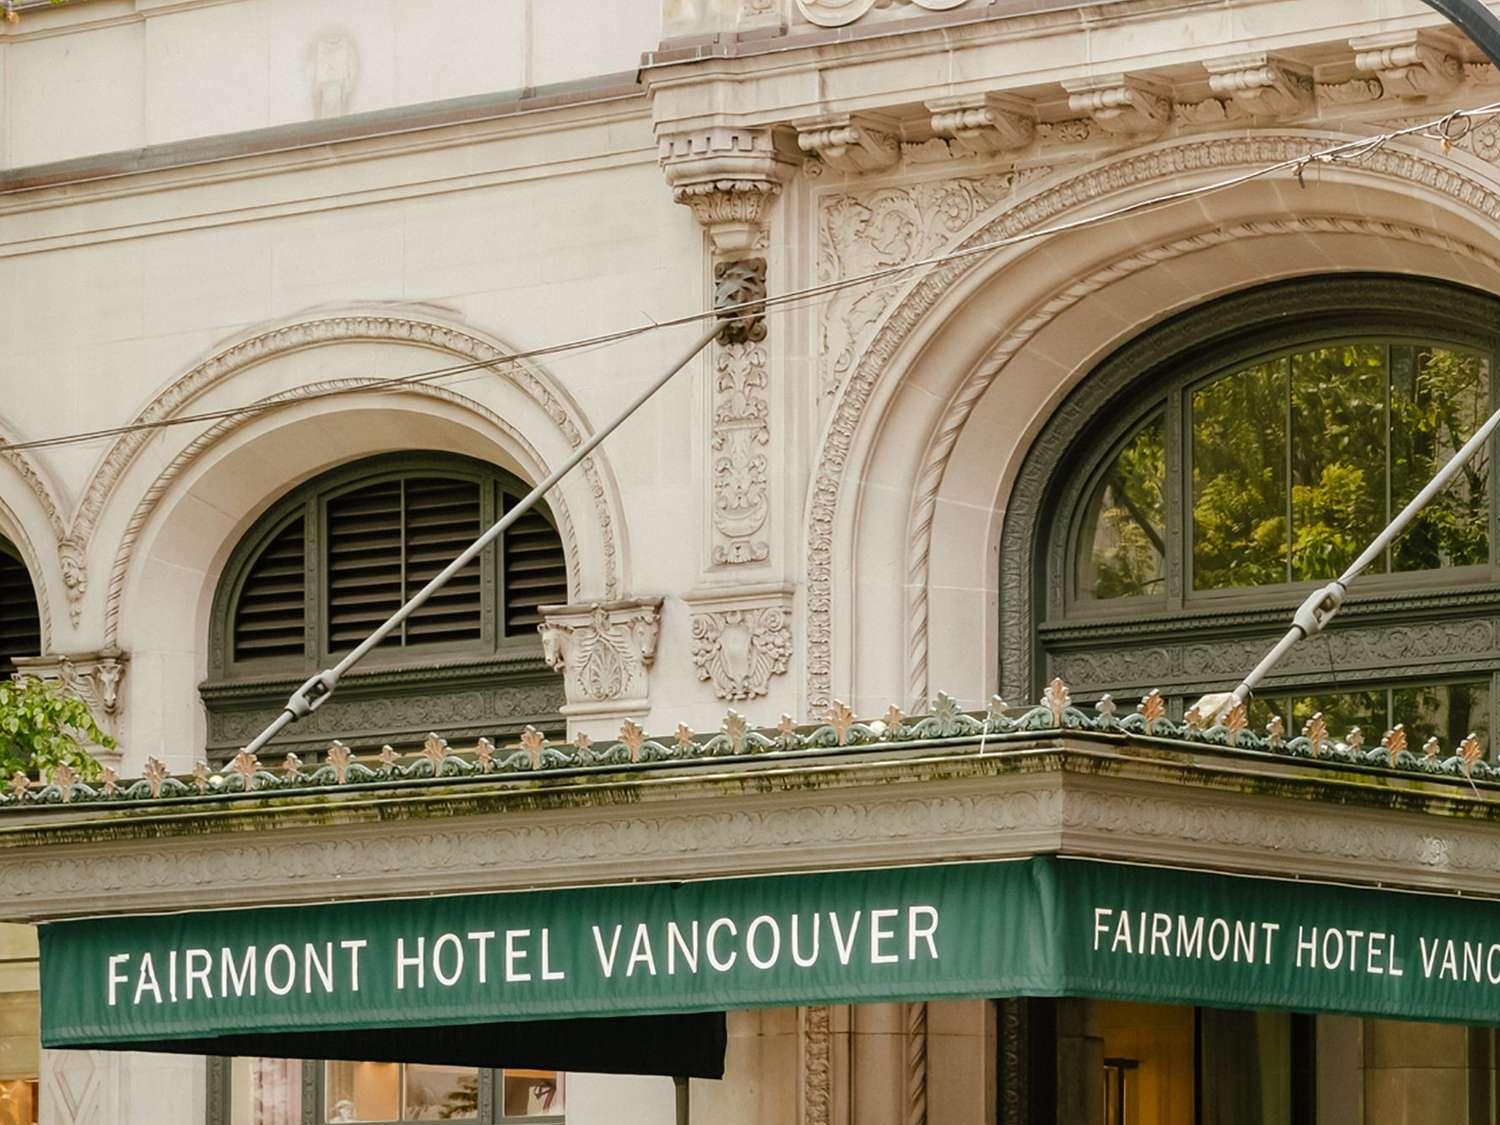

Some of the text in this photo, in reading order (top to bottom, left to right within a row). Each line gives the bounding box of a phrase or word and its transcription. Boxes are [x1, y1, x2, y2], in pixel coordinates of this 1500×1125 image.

[107, 904, 941, 1007] FAIRMONT HOTEL VANCOUVER
[1093, 906, 1281, 966] FAIRMONT
[1295, 926, 1405, 978] HOTEL
